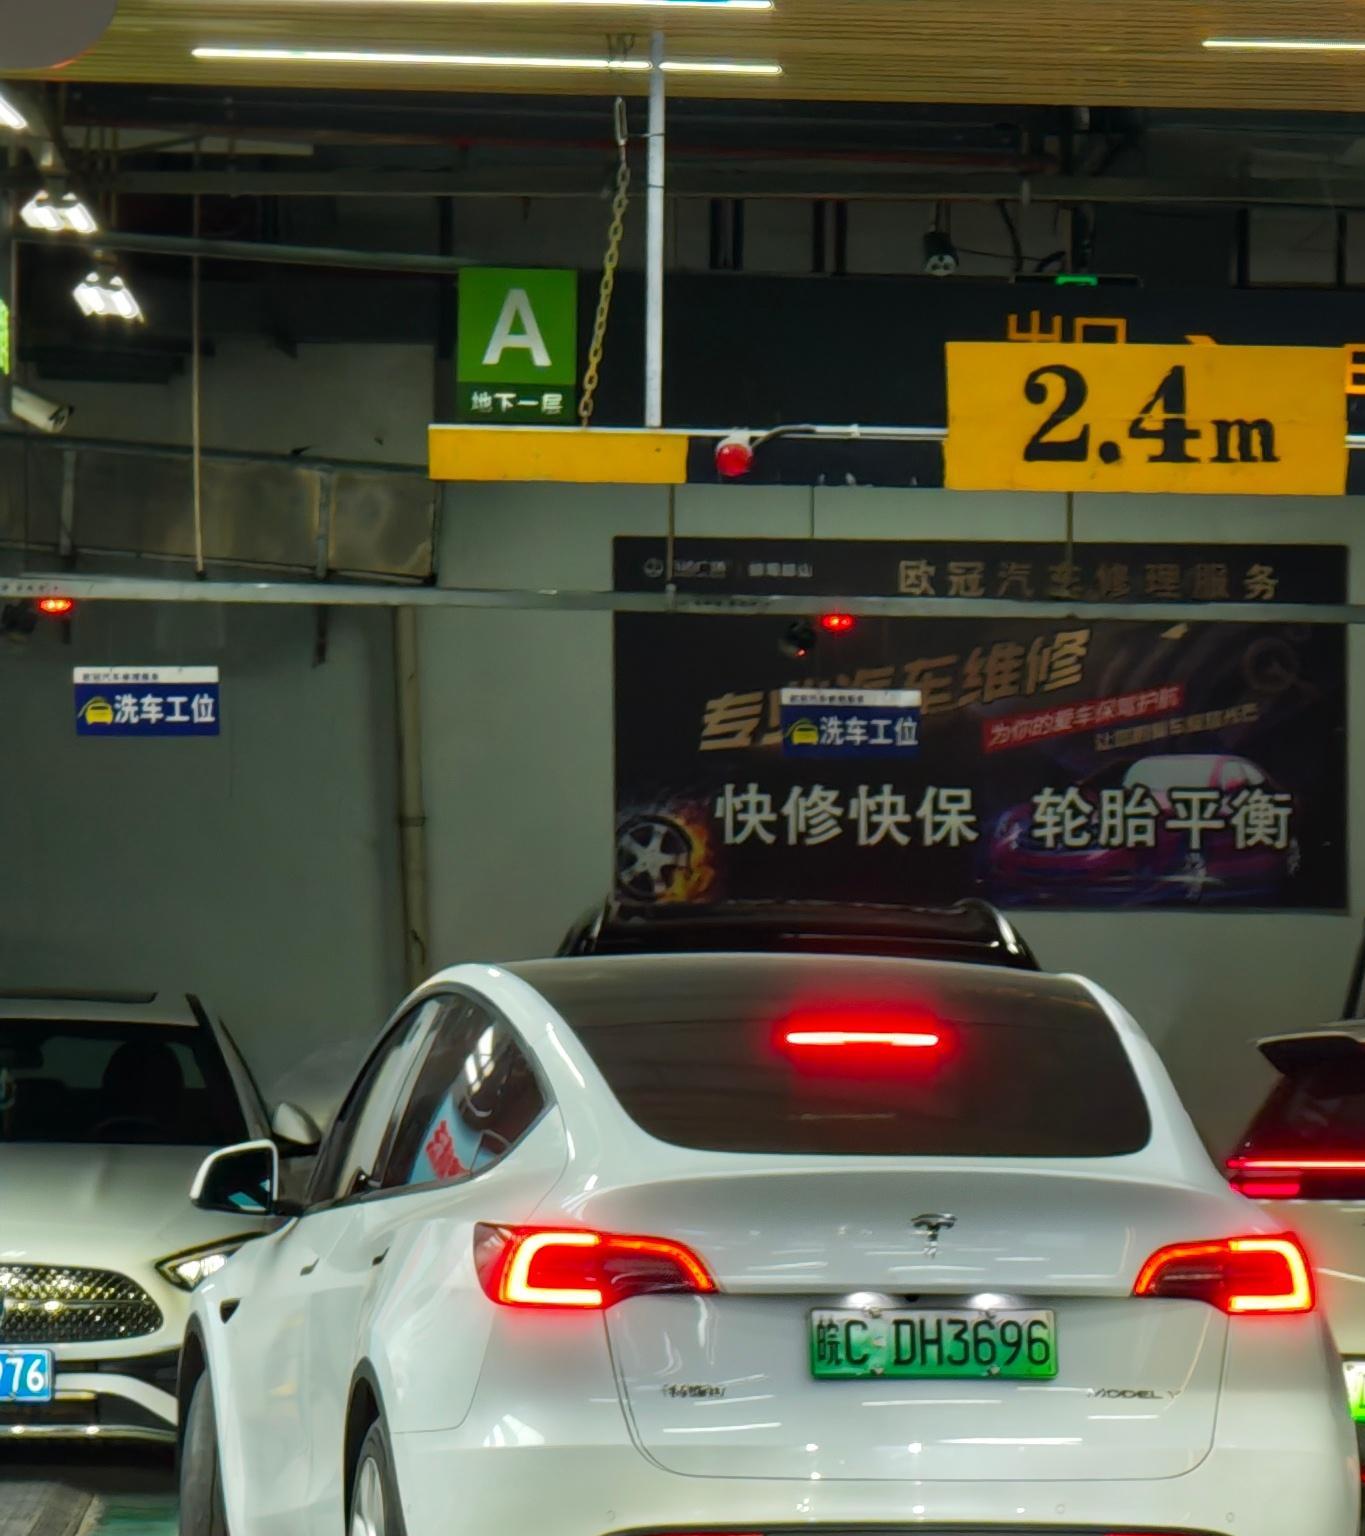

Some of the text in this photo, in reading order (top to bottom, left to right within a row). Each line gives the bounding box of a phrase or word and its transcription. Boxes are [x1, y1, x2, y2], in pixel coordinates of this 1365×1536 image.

[482, 288, 552, 367] A
[470, 391, 564, 415] 地下一层
[1023, 364, 1280, 465] 2.4m
[113, 693, 216, 724] 洗车工位
[818, 714, 920, 747] 洗车工位
[715, 783, 980, 848] 快修快保
[1032, 786, 1292, 850] 轮胎平衡
[815, 1317, 1051, 1366] 皖C DH3696
[0, 1357, 44, 1393] 76
